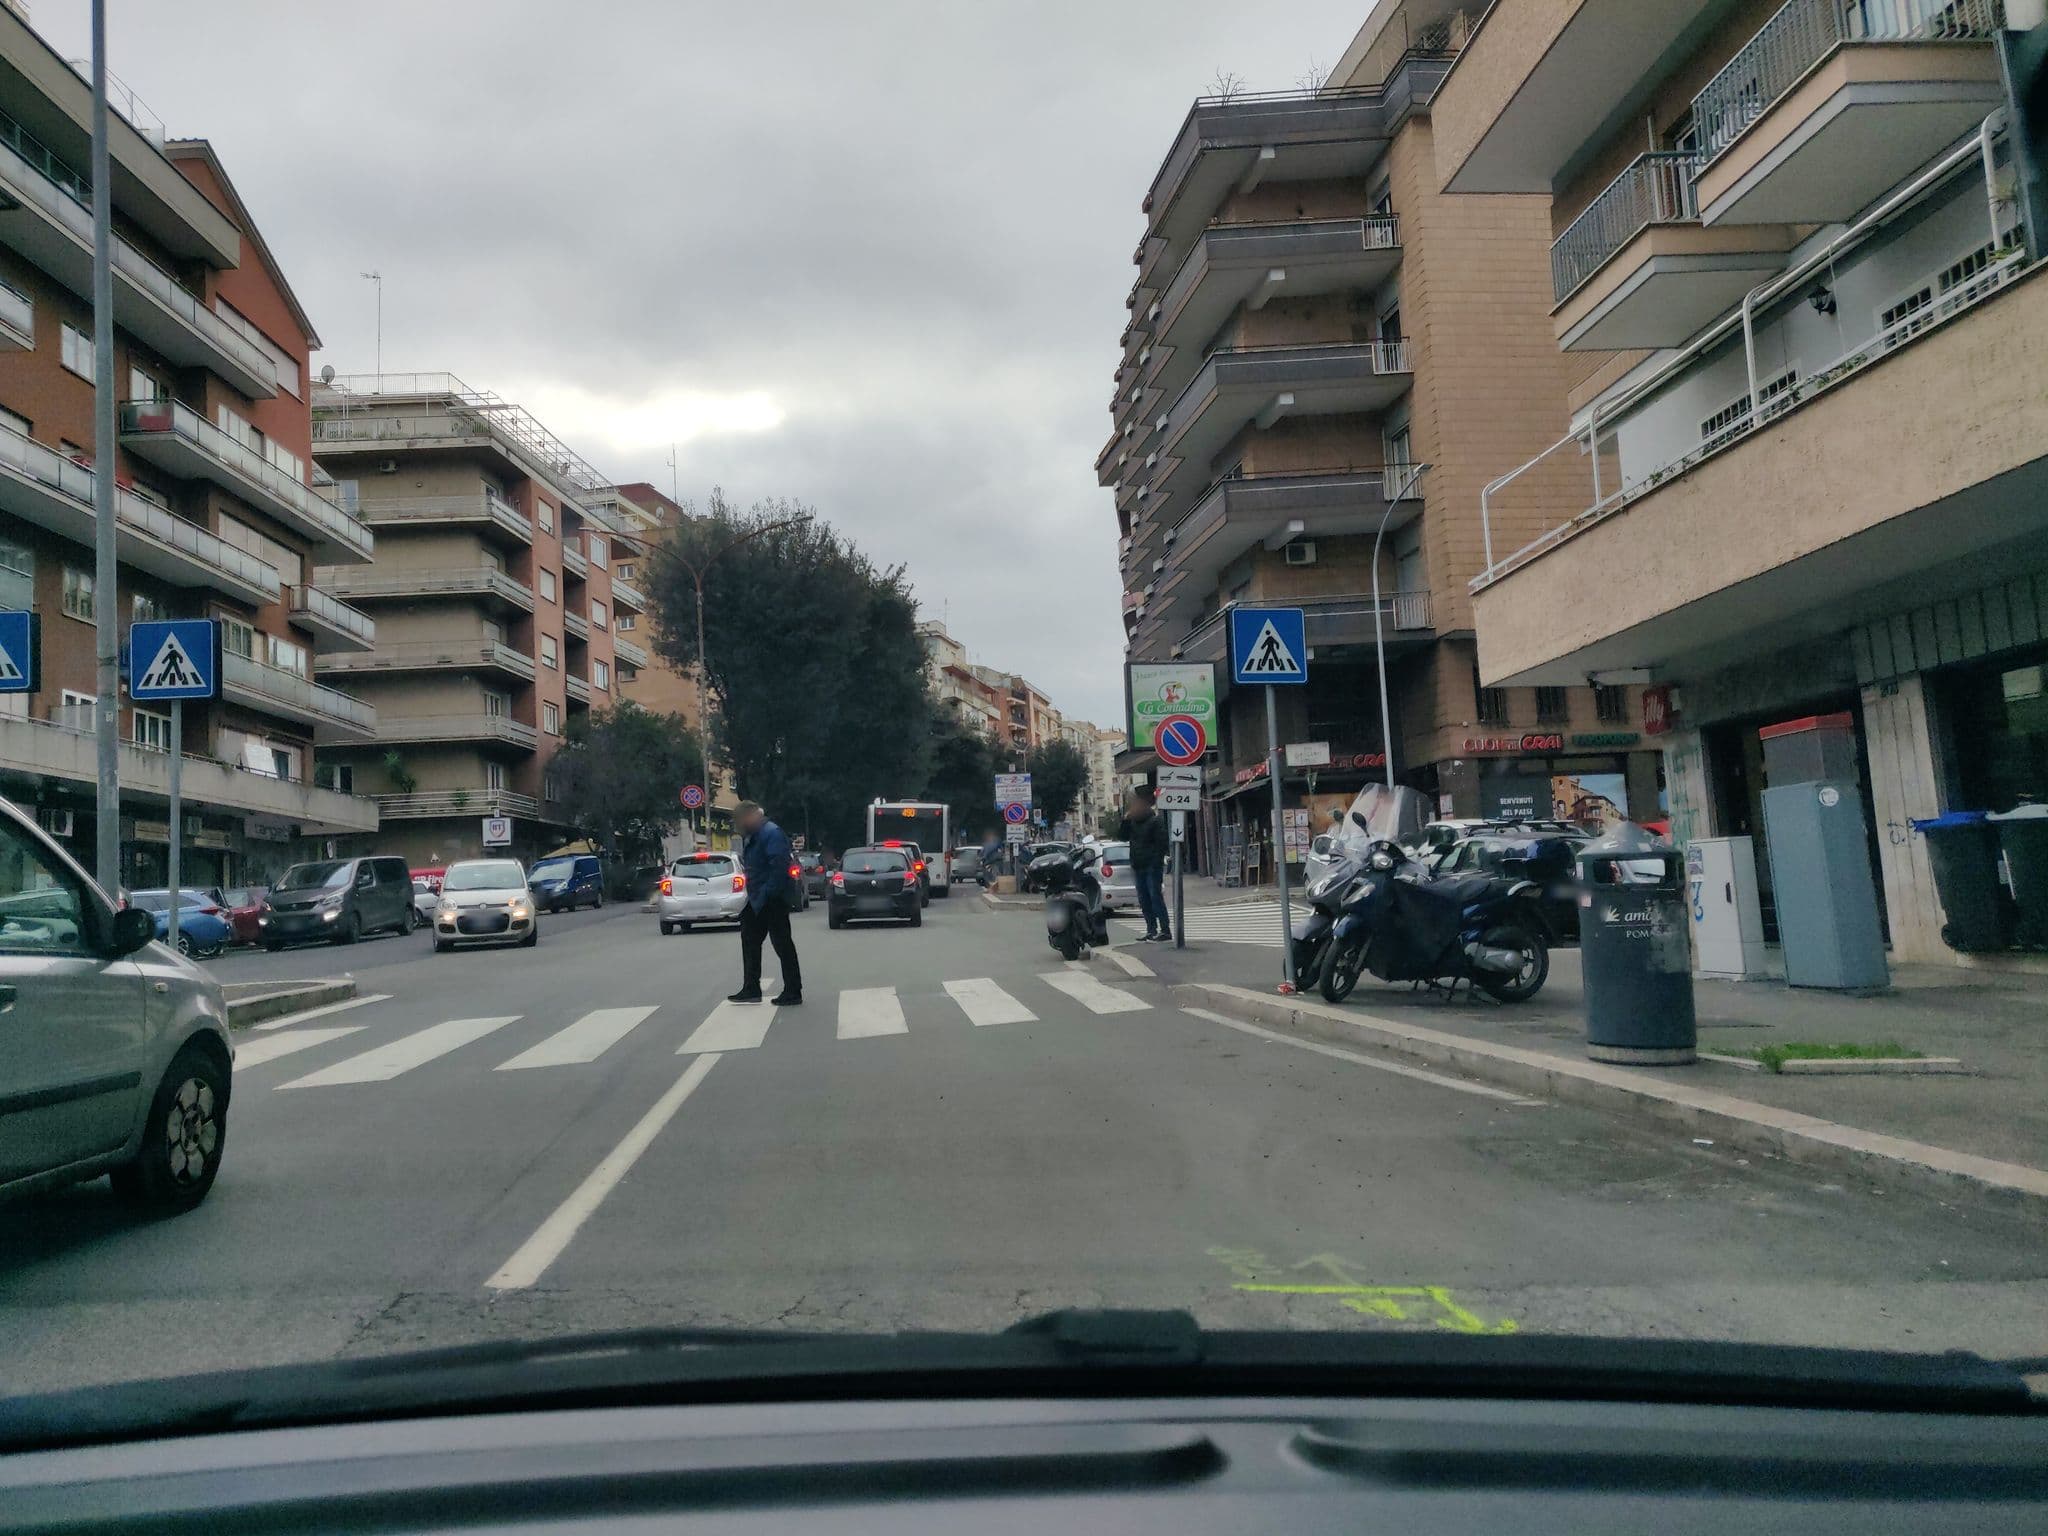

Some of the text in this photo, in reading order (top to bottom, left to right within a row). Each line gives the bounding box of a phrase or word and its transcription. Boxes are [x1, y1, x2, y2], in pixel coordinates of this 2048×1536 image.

[1143, 701, 1205, 714] La Contadina
[1645, 695, 1665, 723] illy
[1521, 734, 1562, 750] CRAI
[1353, 753, 1386, 769] CRA
[1166, 795, 1190, 804] 0-24
[1500, 796, 1534, 805] BENVENUTI
[1514, 808, 1533, 816] PAESE
